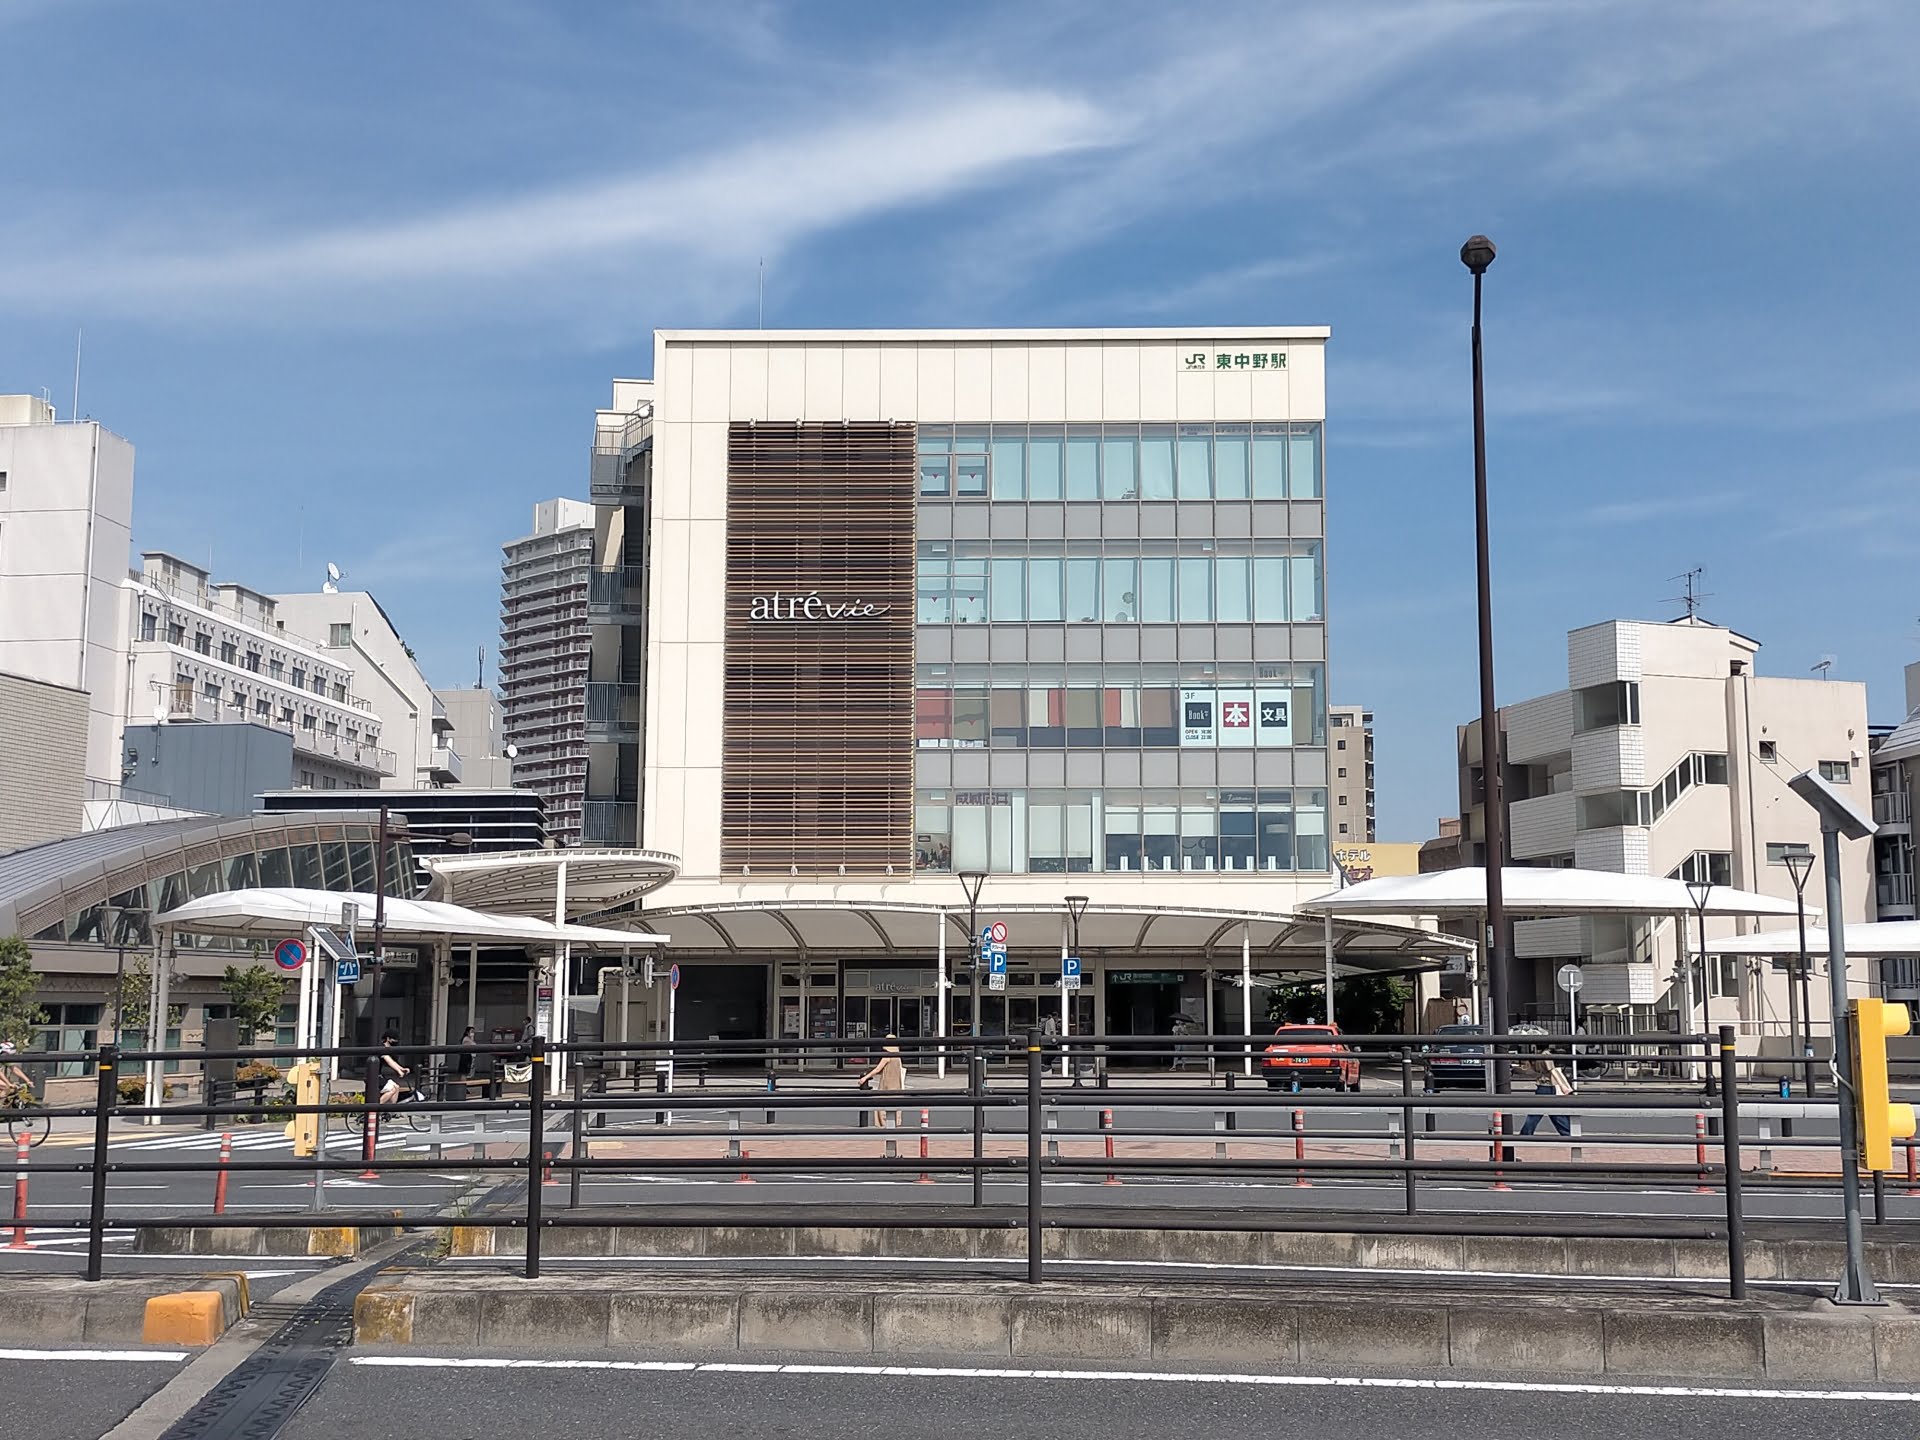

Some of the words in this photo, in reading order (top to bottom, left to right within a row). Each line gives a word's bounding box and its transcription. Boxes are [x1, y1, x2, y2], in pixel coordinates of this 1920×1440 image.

[1185, 353, 1205, 364] JR
[1216, 353, 1286, 369] 東中野駅
[1224, 703, 1248, 727] 本
[1262, 707, 1287, 722] 文具
[1335, 848, 1371, 862] ホテル
[994, 953, 1004, 971] P
[1067, 960, 1077, 974] P
[1119, 973, 1132, 981] JR
